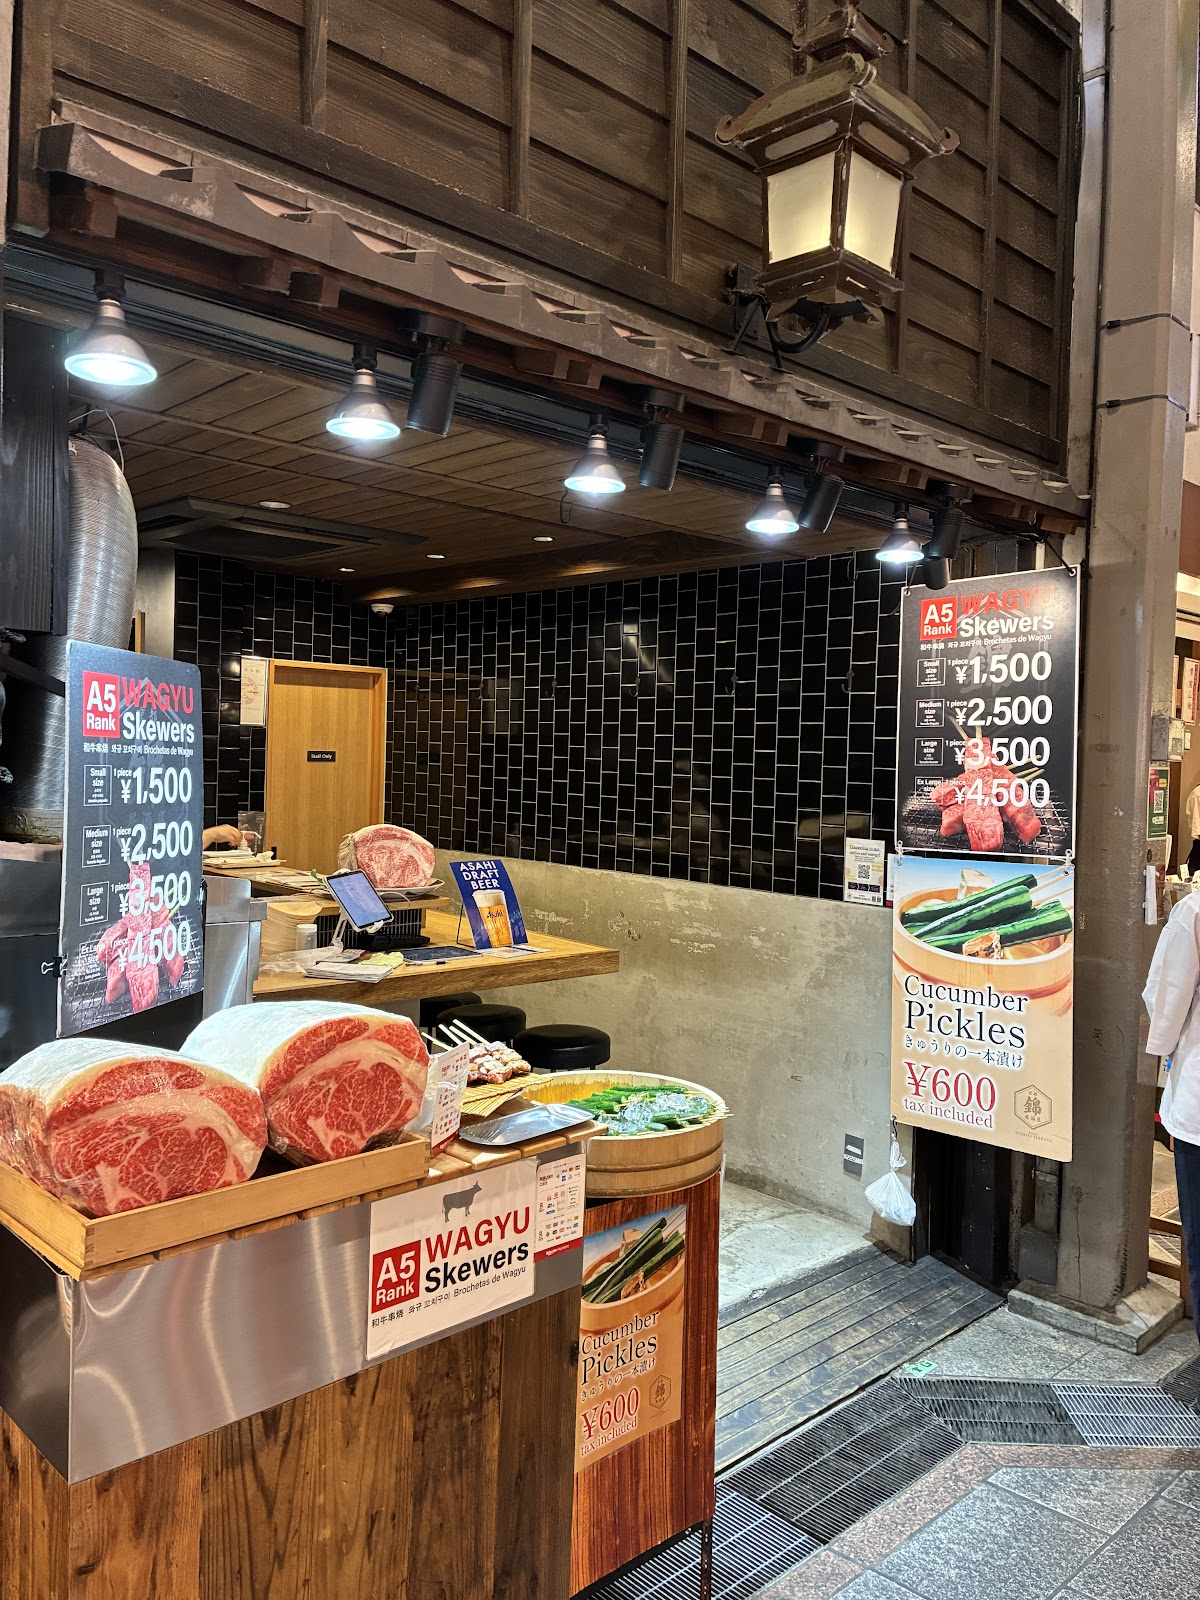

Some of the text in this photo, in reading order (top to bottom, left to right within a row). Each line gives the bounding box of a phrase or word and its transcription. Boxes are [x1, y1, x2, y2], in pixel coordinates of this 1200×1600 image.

[924, 603, 954, 624] A5
[961, 586, 1056, 615] WAGYU
[924, 624, 952, 636] Rank
[960, 614, 1054, 638] Skewers
[984, 637, 1017, 646] Brochetas
[1028, 634, 1052, 643] Wagyu
[924, 660, 940, 668] Small
[952, 658, 968, 667] piece
[956, 651, 1052, 684] ¥1,500
[86, 681, 116, 712] A5
[122, 677, 193, 714] WAGYU
[951, 700, 967, 708] piece
[86, 713, 116, 731] Rank
[956, 695, 1052, 726] ¥2,500
[122, 712, 194, 743] Skewers
[144, 745, 170, 755] Brochetas
[171, 747, 177, 755] de
[178, 748, 193, 758] Wagyu
[954, 736, 1050, 766] ¥3,500
[90, 768, 106, 776] Small
[92, 778, 104, 787] size
[117, 768, 132, 778] piece
[950, 779, 966, 787] piece
[120, 767, 192, 805] ¥1,500
[955, 778, 1050, 808] ¥4,500
[86, 828, 108, 838] Medium
[91, 839, 102, 848] size
[117, 827, 131, 838] piece
[121, 820, 193, 862] ¥2,500
[460, 861, 496, 871] ASAHI
[462, 869, 499, 880] DRAFT
[87, 886, 103, 897] Large
[115, 882, 130, 893] piece
[119, 871, 191, 917] ¥3,500
[471, 879, 500, 890] BEER
[89, 897, 100, 906] size
[114, 937, 129, 949] piece
[118, 921, 190, 972] ¥4,500
[904, 974, 1028, 1012] Cucumber
[904, 999, 1025, 1049] Pickles
[905, 1035, 1023, 1068] きゅうりの一本漬け
[904, 1061, 996, 1112] ¥600
[904, 1096, 993, 1129] tax included
[1024, 1096, 1042, 1116] 錦
[425, 1206, 530, 1264] WAGYU
[376, 1251, 415, 1288] A5
[424, 1242, 529, 1294] Skewers
[376, 1281, 415, 1306] Rank
[454, 1278, 490, 1297] Brochetas
[492, 1274, 501, 1283] de
[502, 1267, 526, 1279] Wagyu
[581, 1311, 660, 1355] Cucumber
[581, 1336, 657, 1386] Pickles
[581, 1387, 640, 1440] ¥600
[581, 1416, 637, 1456] tax included
